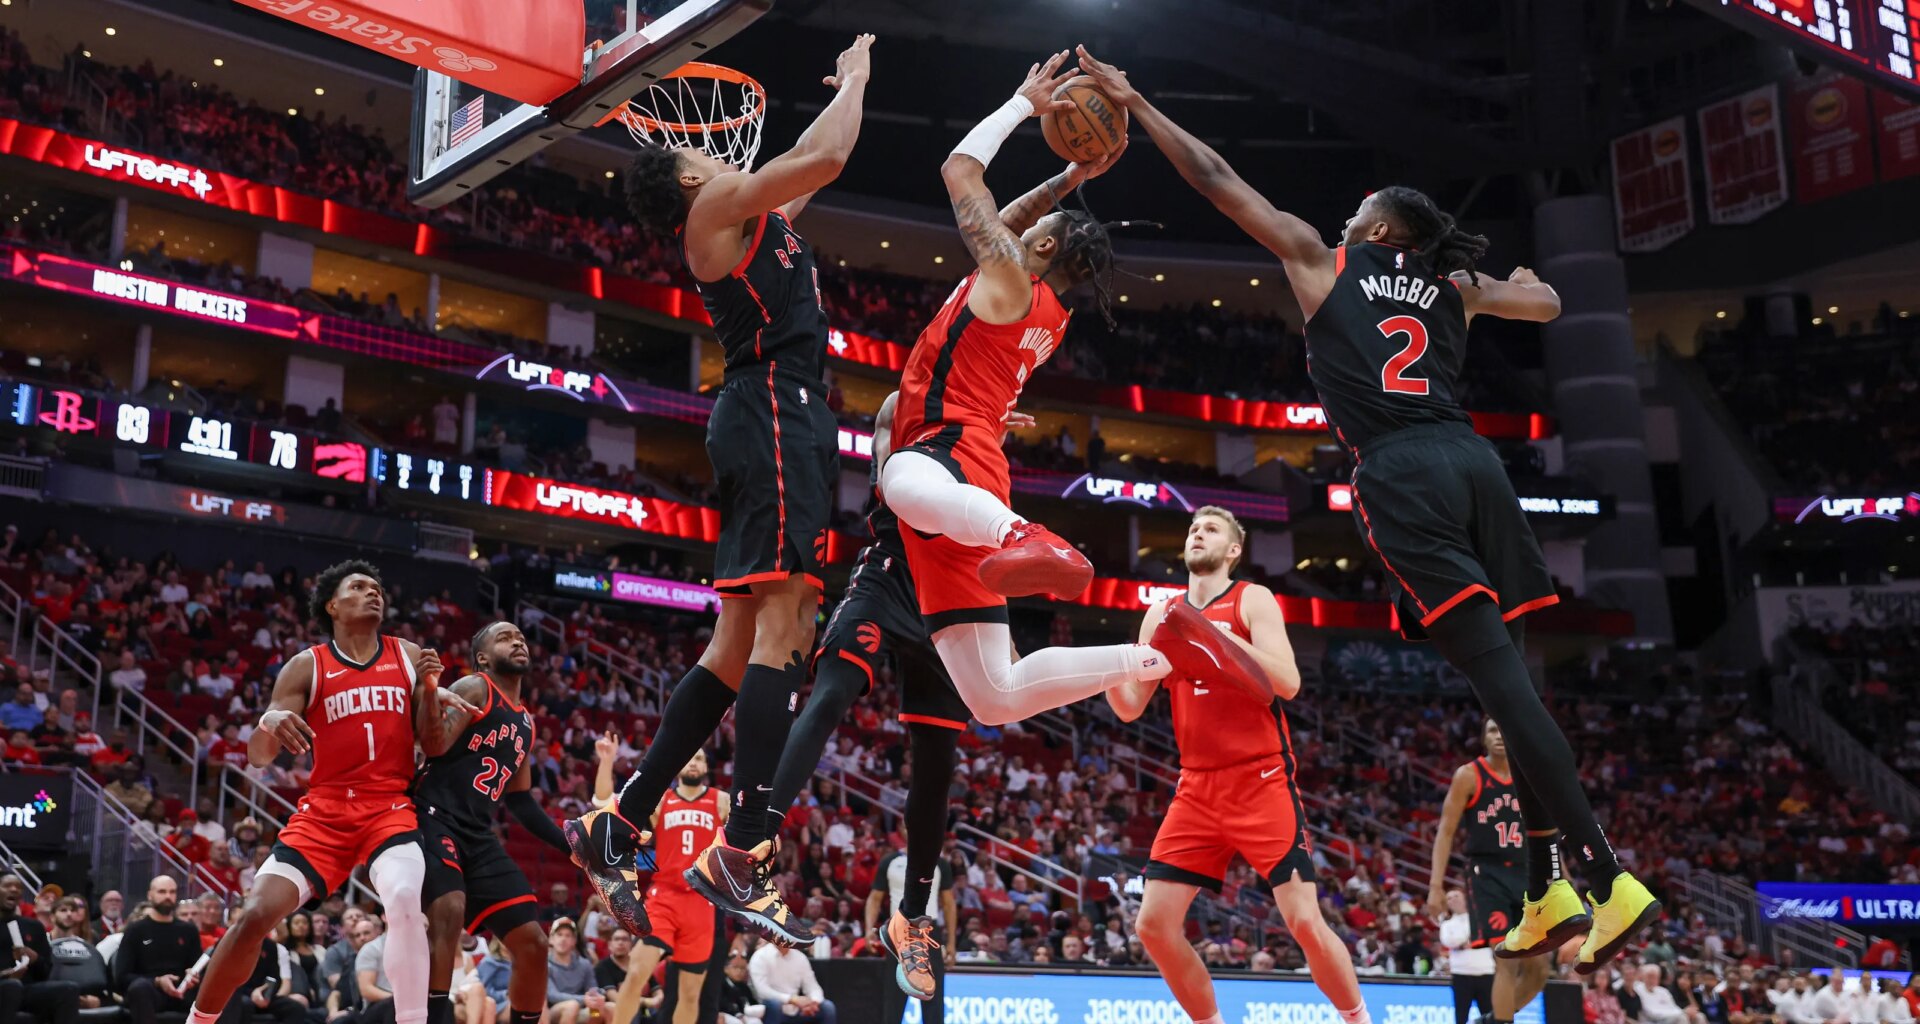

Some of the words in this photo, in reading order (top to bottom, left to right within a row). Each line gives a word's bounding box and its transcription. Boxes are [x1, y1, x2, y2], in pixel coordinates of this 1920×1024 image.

[307, 5, 432, 54] State
[85, 144, 189, 187] LIFTOFF
[93, 269, 168, 307] HOUSTON
[175, 287, 247, 323] ROCKETS
[1359, 275, 1440, 310] MOGBO
[1377, 315, 1429, 395] 2
[508, 357, 591, 392] LIFTOFF
[116, 403, 150, 444] 83
[269, 430, 297, 469] 76
[537, 483, 627, 518] LIFTOFF
[1086, 477, 1157, 500] LIFTOFF
[1561, 499, 1600, 514] ZONE
[556, 572, 596, 590] reliant
[616, 580, 671, 600] OFFICIAL
[324, 685, 406, 724] ROCKETS
[363, 722, 375, 761] 1
[664, 809, 714, 831] ROCKETS
[1494, 821, 1523, 848] 14
[682, 829, 694, 855] 9
